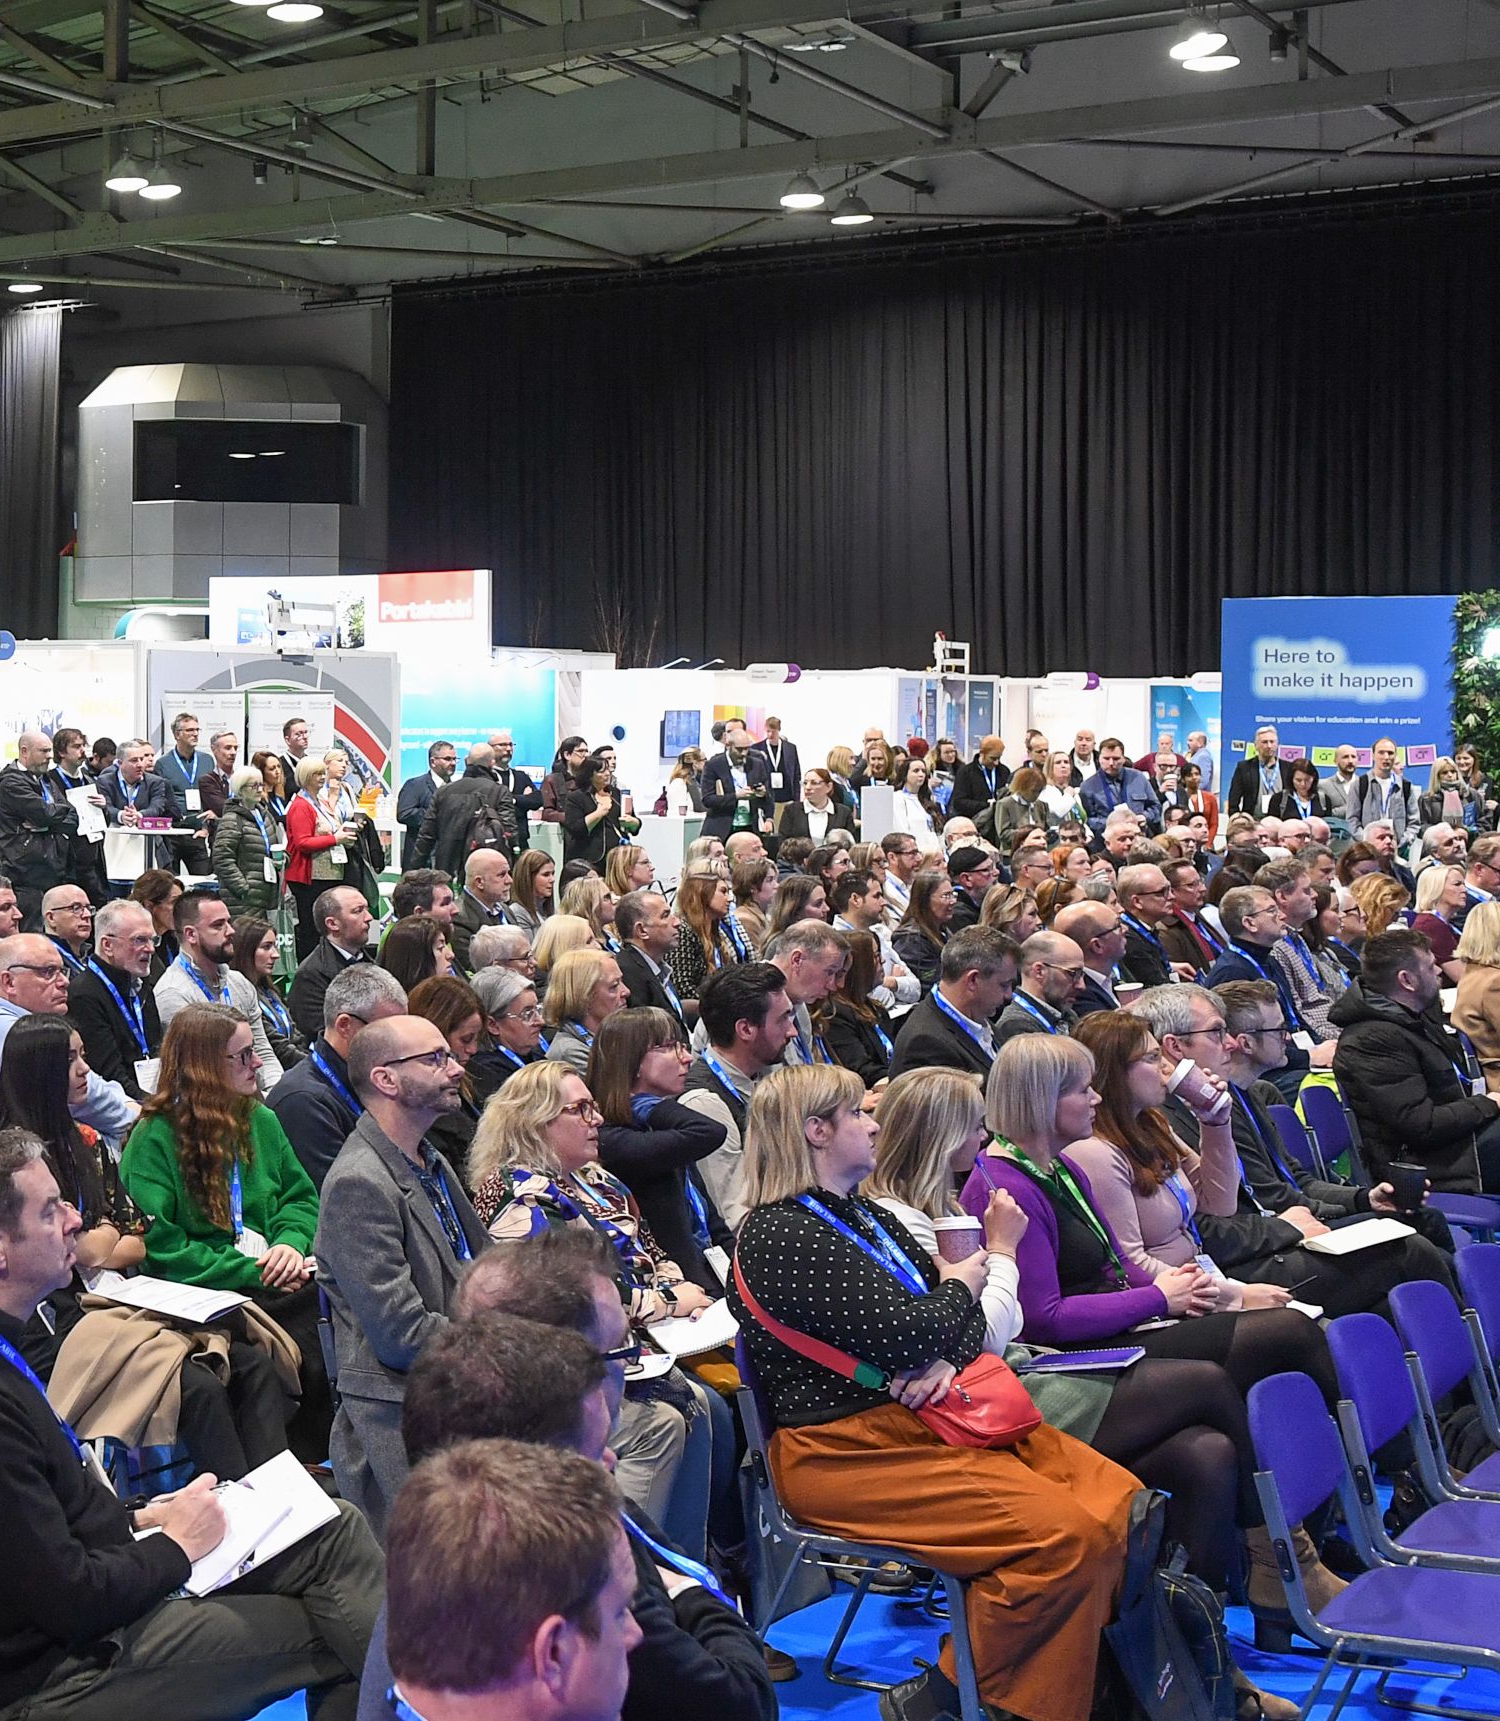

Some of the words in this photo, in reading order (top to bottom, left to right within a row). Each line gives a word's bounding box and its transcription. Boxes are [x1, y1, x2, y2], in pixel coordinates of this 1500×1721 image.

[1264, 648, 1309, 663] Here
[1316, 649, 1335, 663] to
[1263, 672, 1314, 688] make
[1321, 672, 1333, 687] it
[1340, 672, 1414, 691] happen
[1255, 715, 1276, 723] Share
[1276, 716, 1293, 724] your
[1327, 716, 1363, 724] education
[1364, 716, 1378, 724] and
[1400, 717, 1421, 725] prize!
[809, 1200, 836, 1223] DELABIE
[870, 1248, 897, 1273] DELABIE
[883, 1237, 906, 1263] DELABIE
